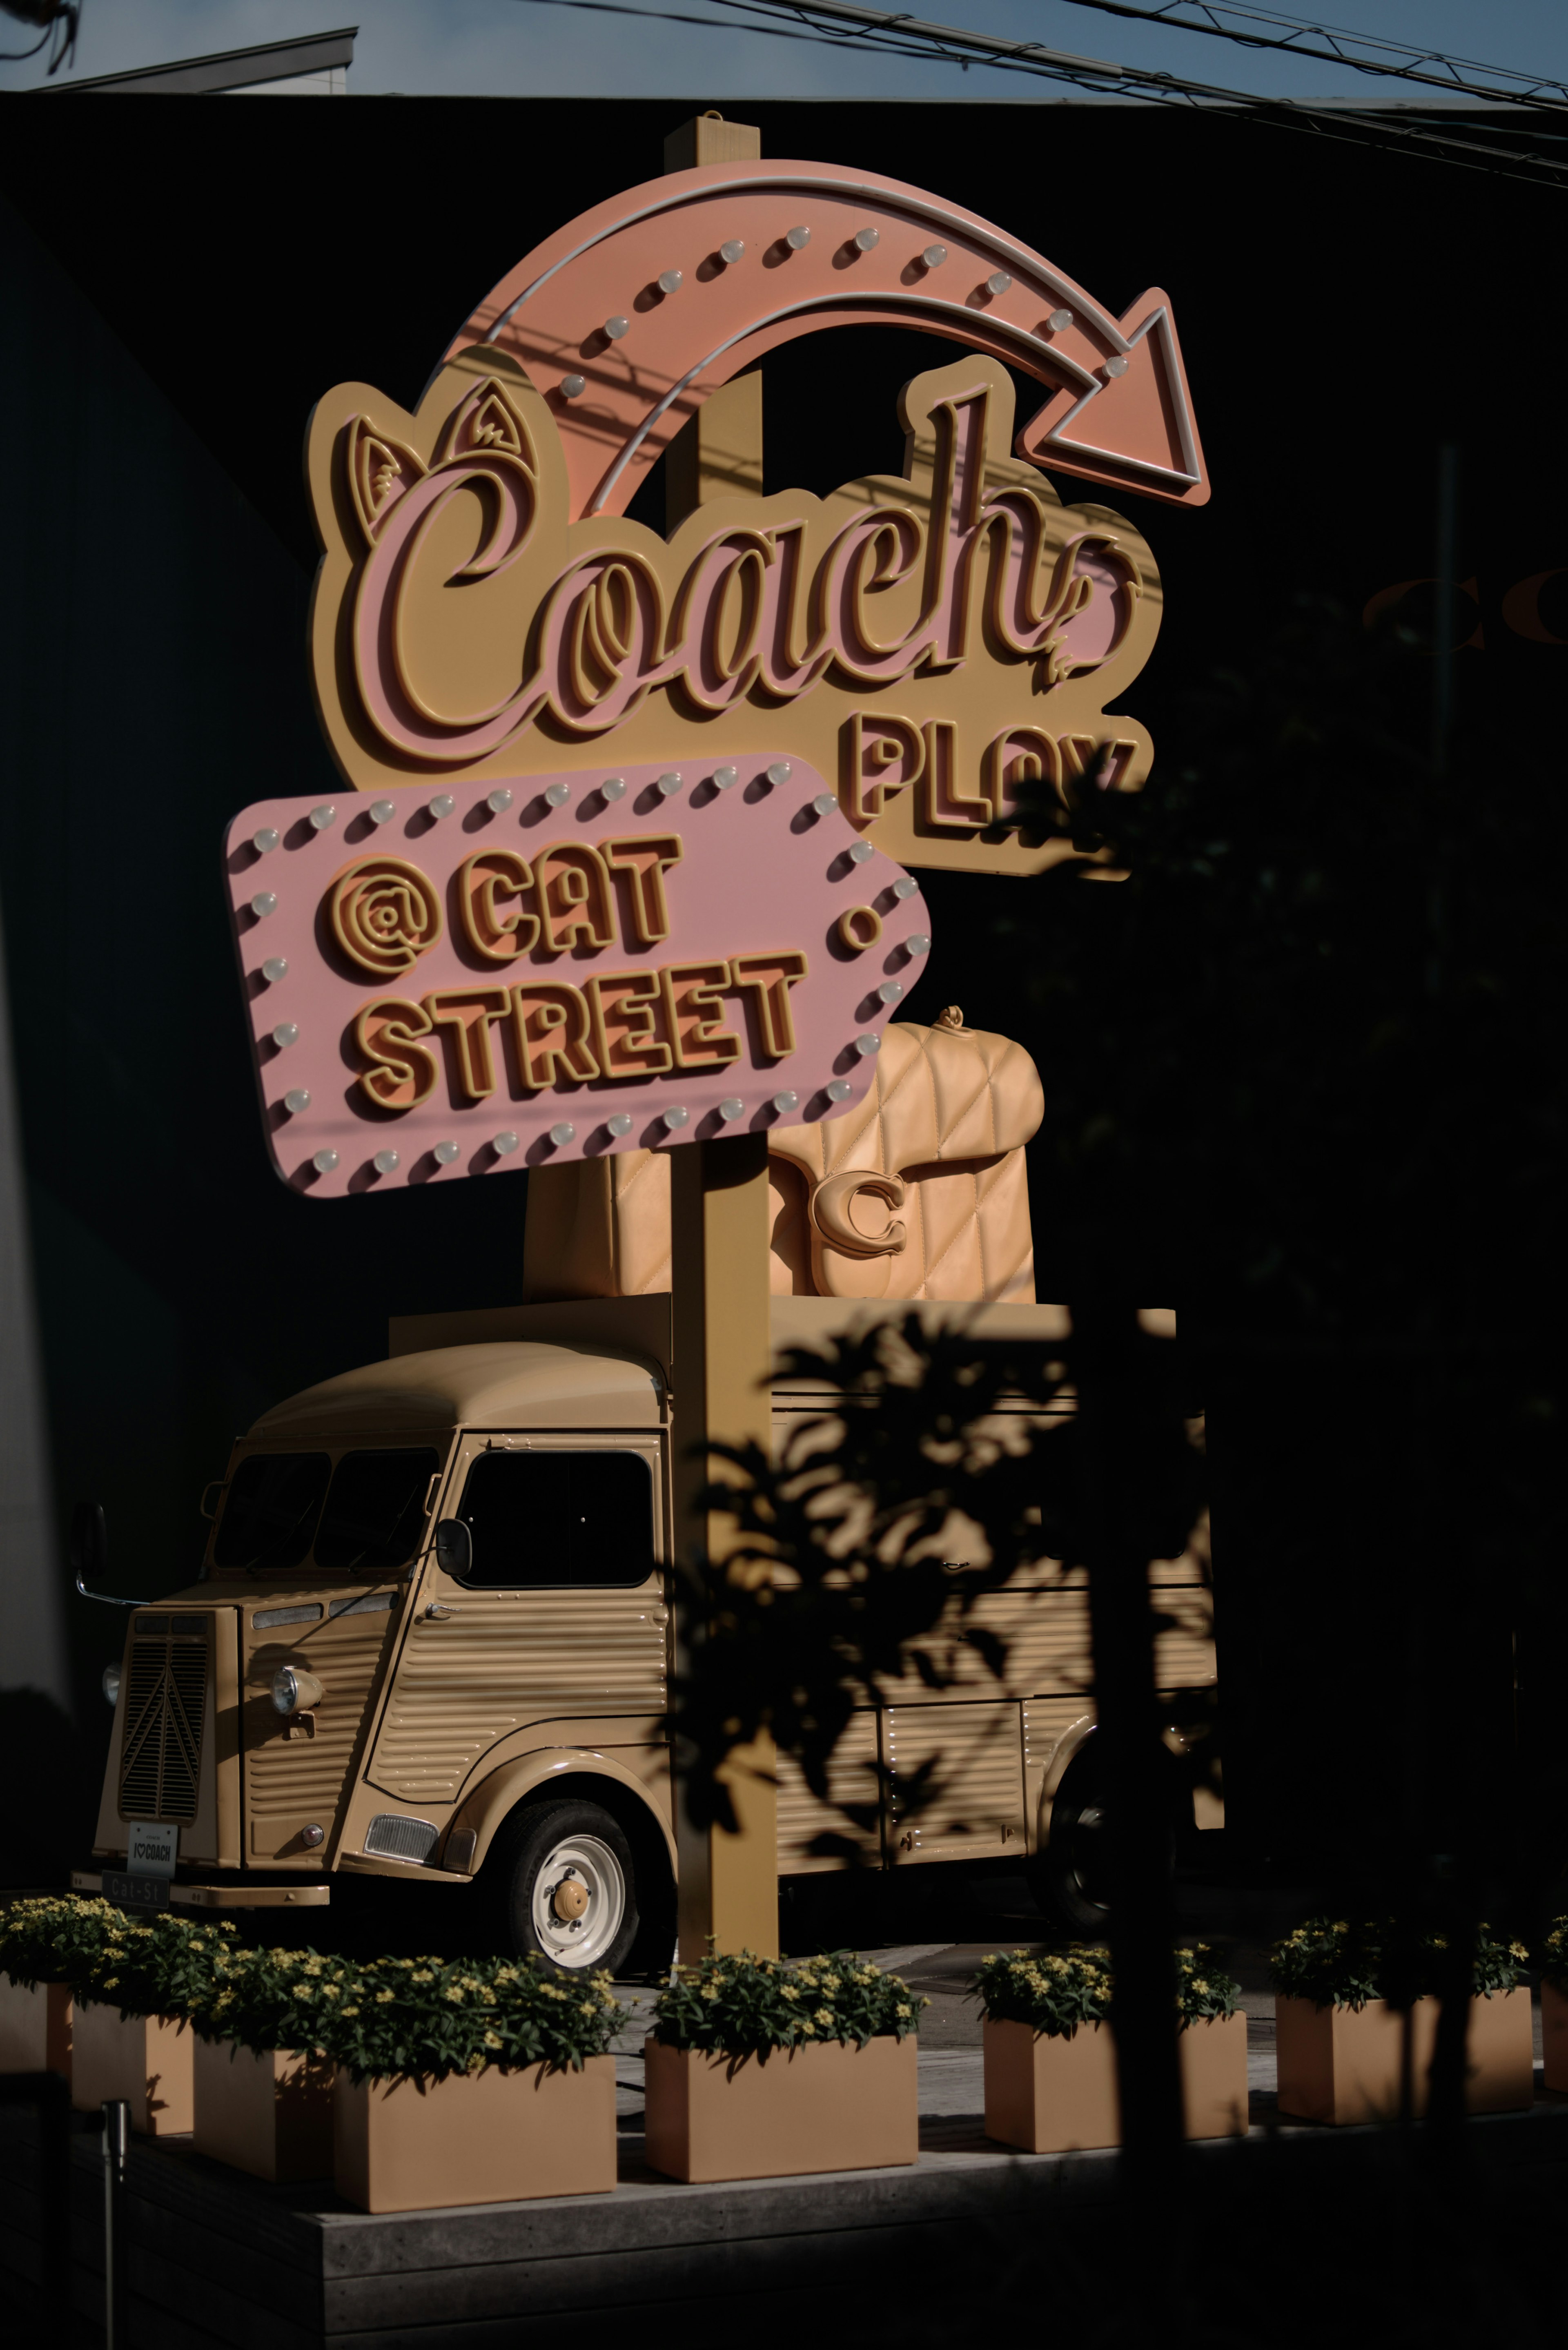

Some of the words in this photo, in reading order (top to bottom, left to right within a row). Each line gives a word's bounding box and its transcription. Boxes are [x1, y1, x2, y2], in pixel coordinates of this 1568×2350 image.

[352, 950, 808, 1111] STREET
[134, 1843, 137, 1859] I
[146, 1844, 171, 1861] COACH
[111, 1877, 158, 1901] Cat-St
